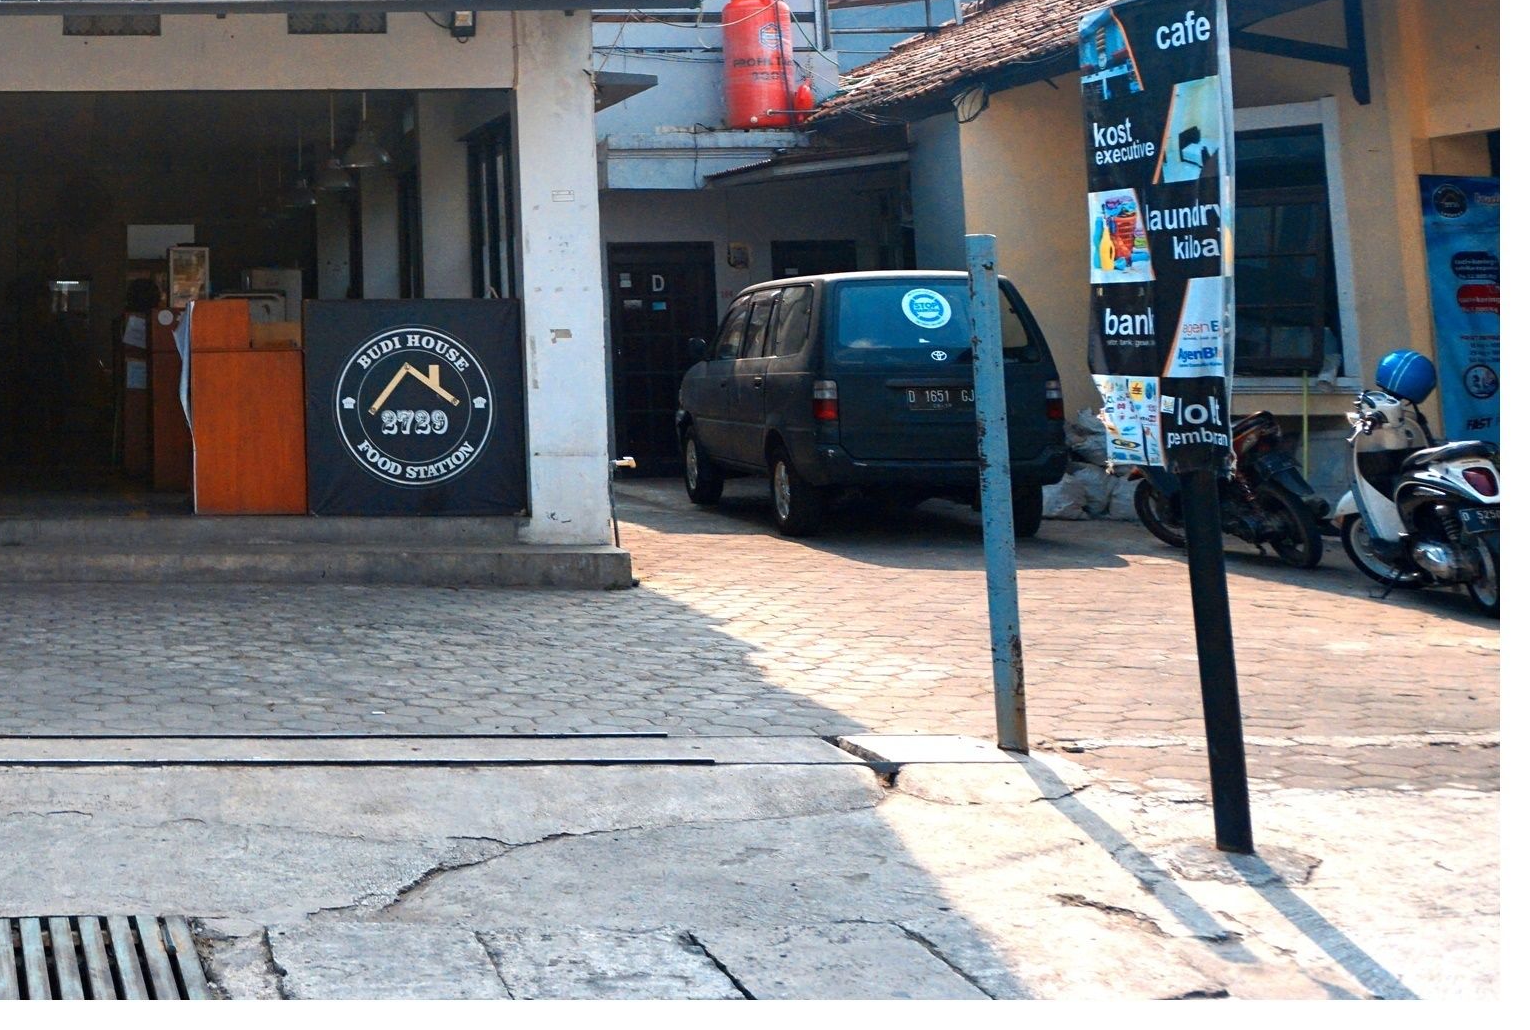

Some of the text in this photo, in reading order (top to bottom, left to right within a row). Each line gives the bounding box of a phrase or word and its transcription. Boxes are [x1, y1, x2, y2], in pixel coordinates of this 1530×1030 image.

[1156, 10, 1211, 50] cafe
[1093, 117, 1133, 148] kost
[1095, 139, 1155, 166] executive
[652, 274, 665, 292] D
[914, 302, 938, 310] STOP
[357, 334, 470, 372] BUDI HOUSE
[908, 390, 916, 403] D
[925, 390, 950, 403] 1651
[380, 409, 449, 435] 2729
[357, 439, 476, 479] FOOD STATION
